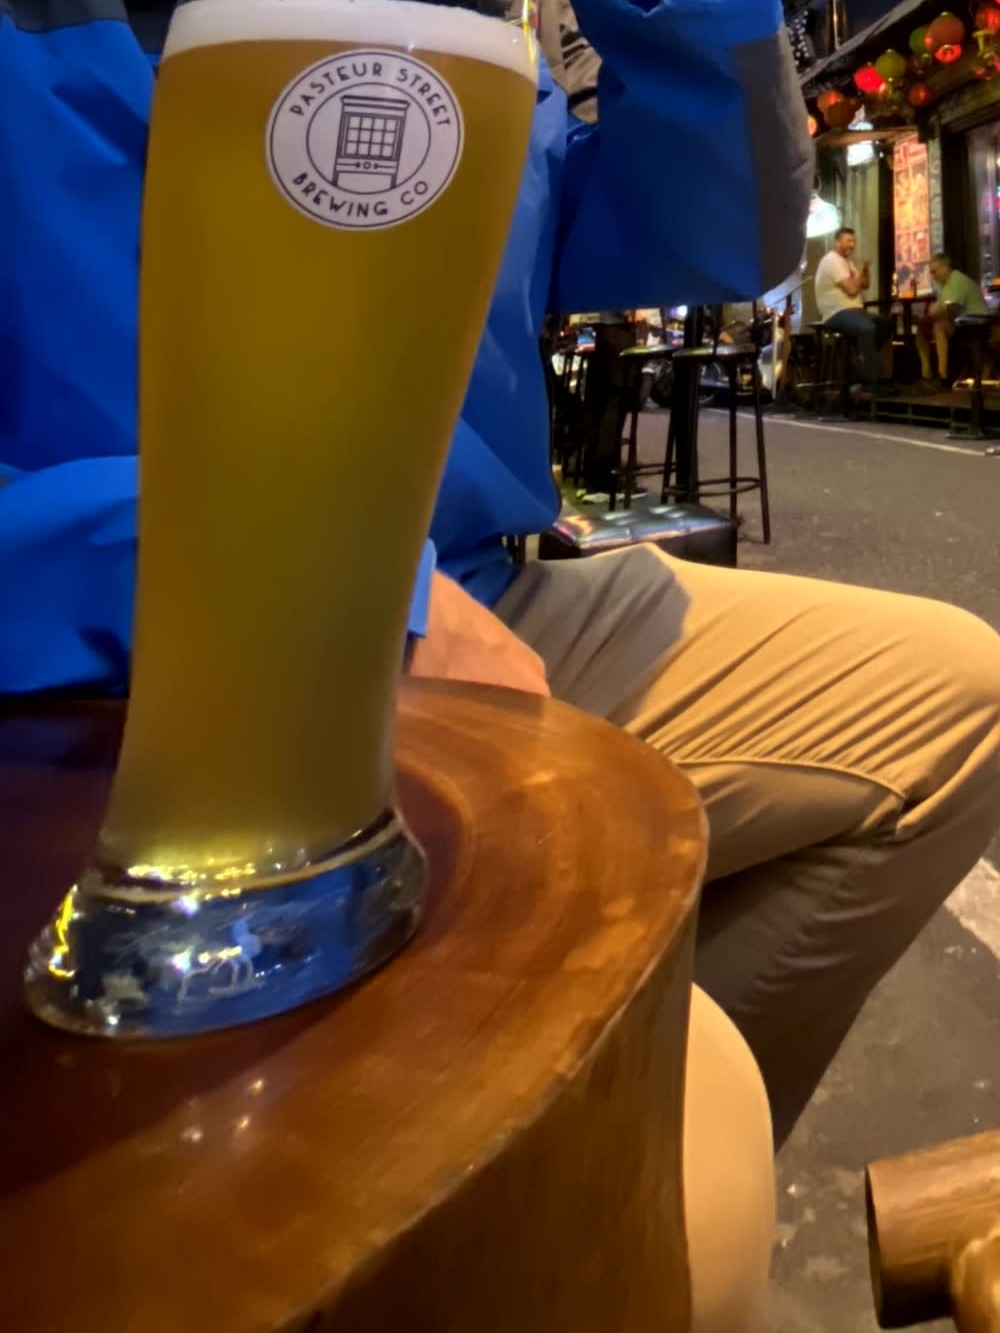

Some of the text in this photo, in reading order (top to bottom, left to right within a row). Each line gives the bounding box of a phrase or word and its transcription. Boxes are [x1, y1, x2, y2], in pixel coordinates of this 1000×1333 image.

[289, 61, 452, 127] PASTEUR STREET
[292, 172, 430, 218] BREWING CO
